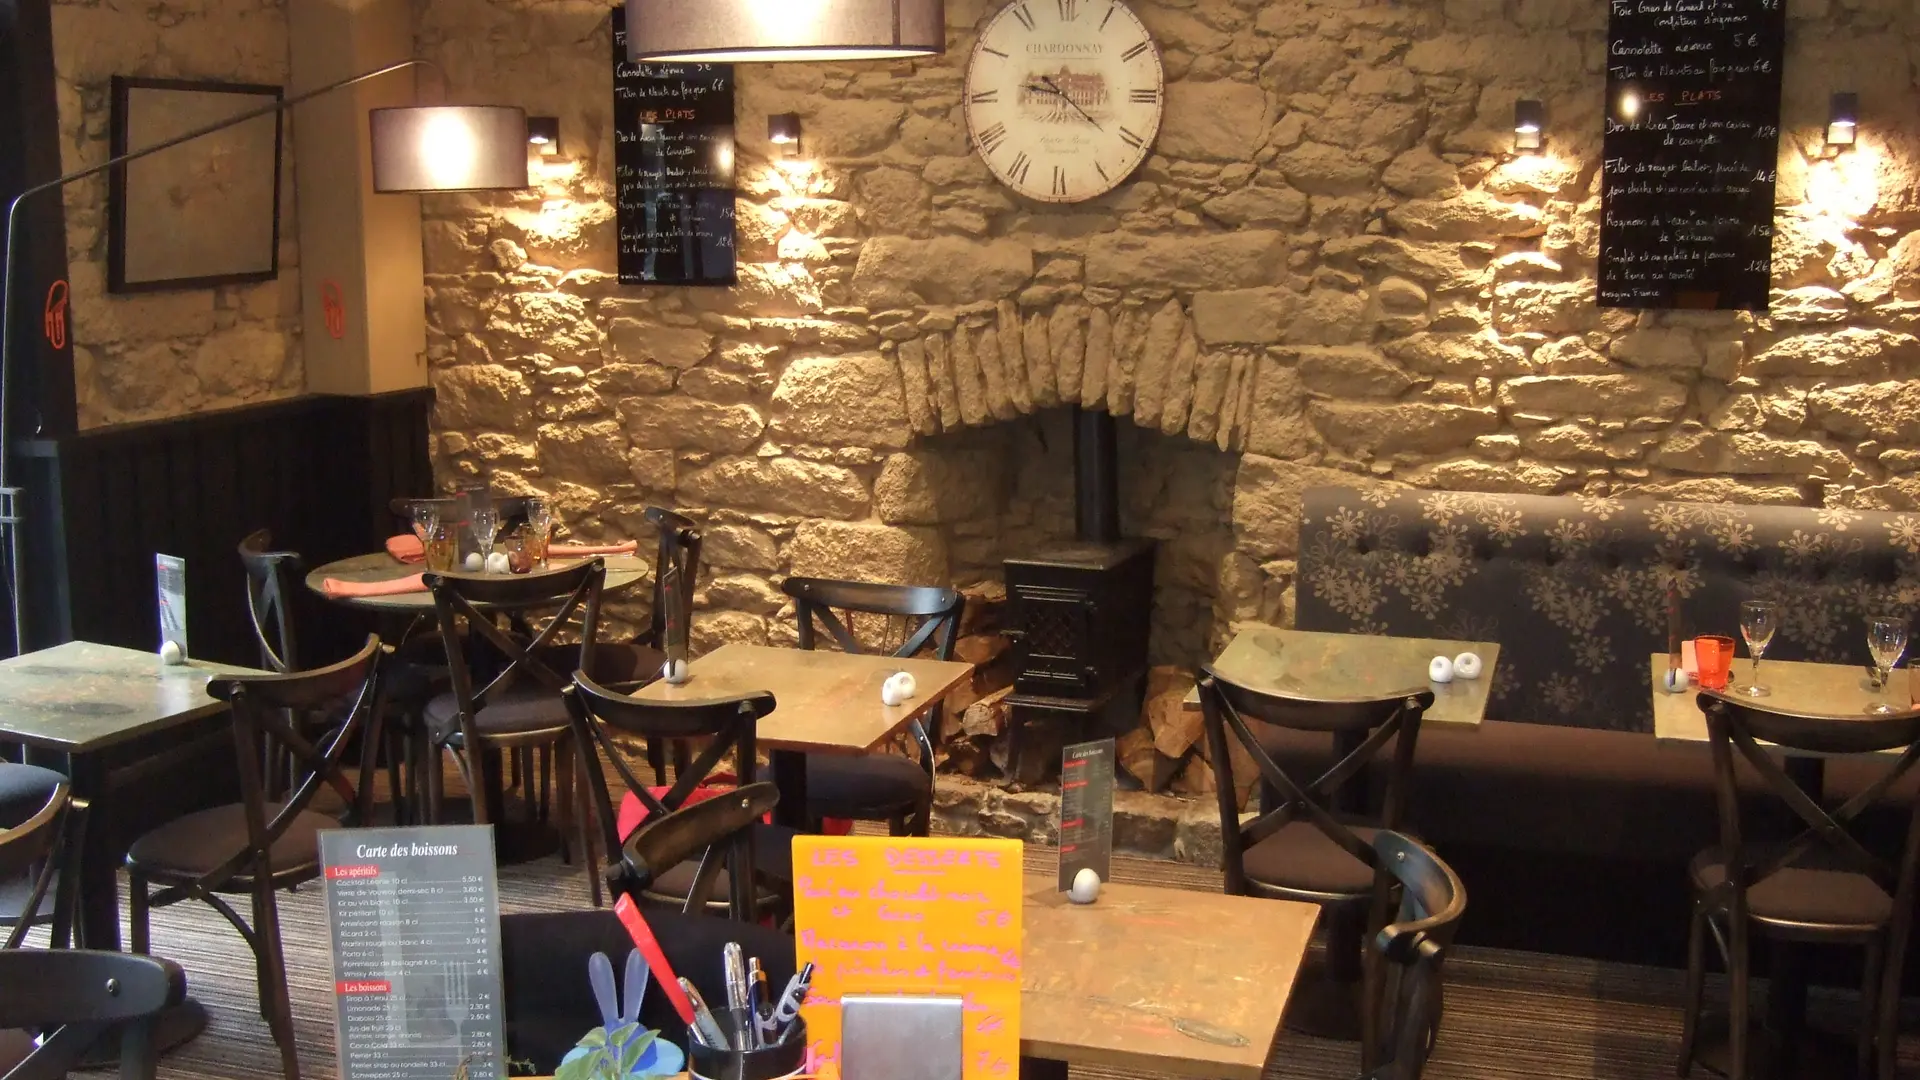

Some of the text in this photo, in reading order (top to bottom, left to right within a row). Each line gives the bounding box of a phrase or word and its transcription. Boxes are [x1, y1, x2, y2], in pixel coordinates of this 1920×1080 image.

[1026, 43, 1102, 53] CHARDONNAY
[356, 842, 458, 859] Carte des boissons
[812, 848, 1002, 868] LES DESSERTS
[335, 866, 376, 877] Les apéritifs
[345, 982, 387, 992] Les boissons
